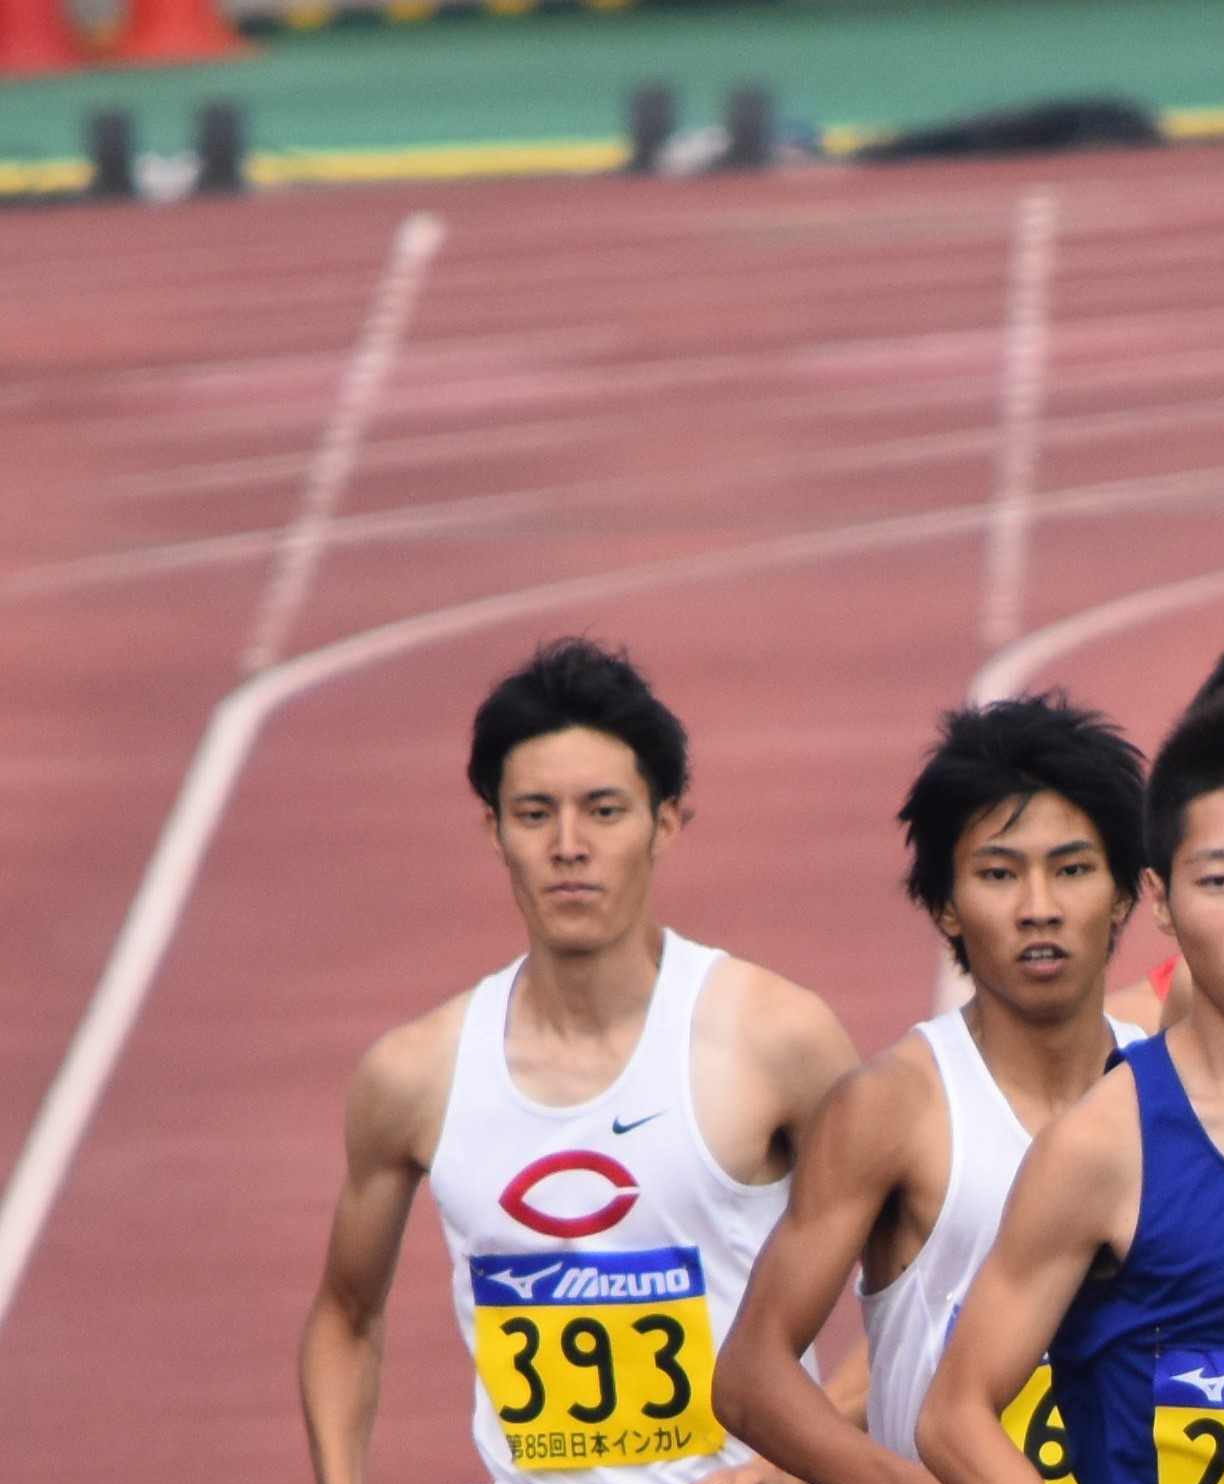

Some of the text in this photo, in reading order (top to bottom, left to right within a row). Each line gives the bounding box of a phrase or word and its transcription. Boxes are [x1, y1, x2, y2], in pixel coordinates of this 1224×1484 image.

[499, 1313, 692, 1424] 393
[505, 1426, 693, 1460] 第85回日本インカレ
